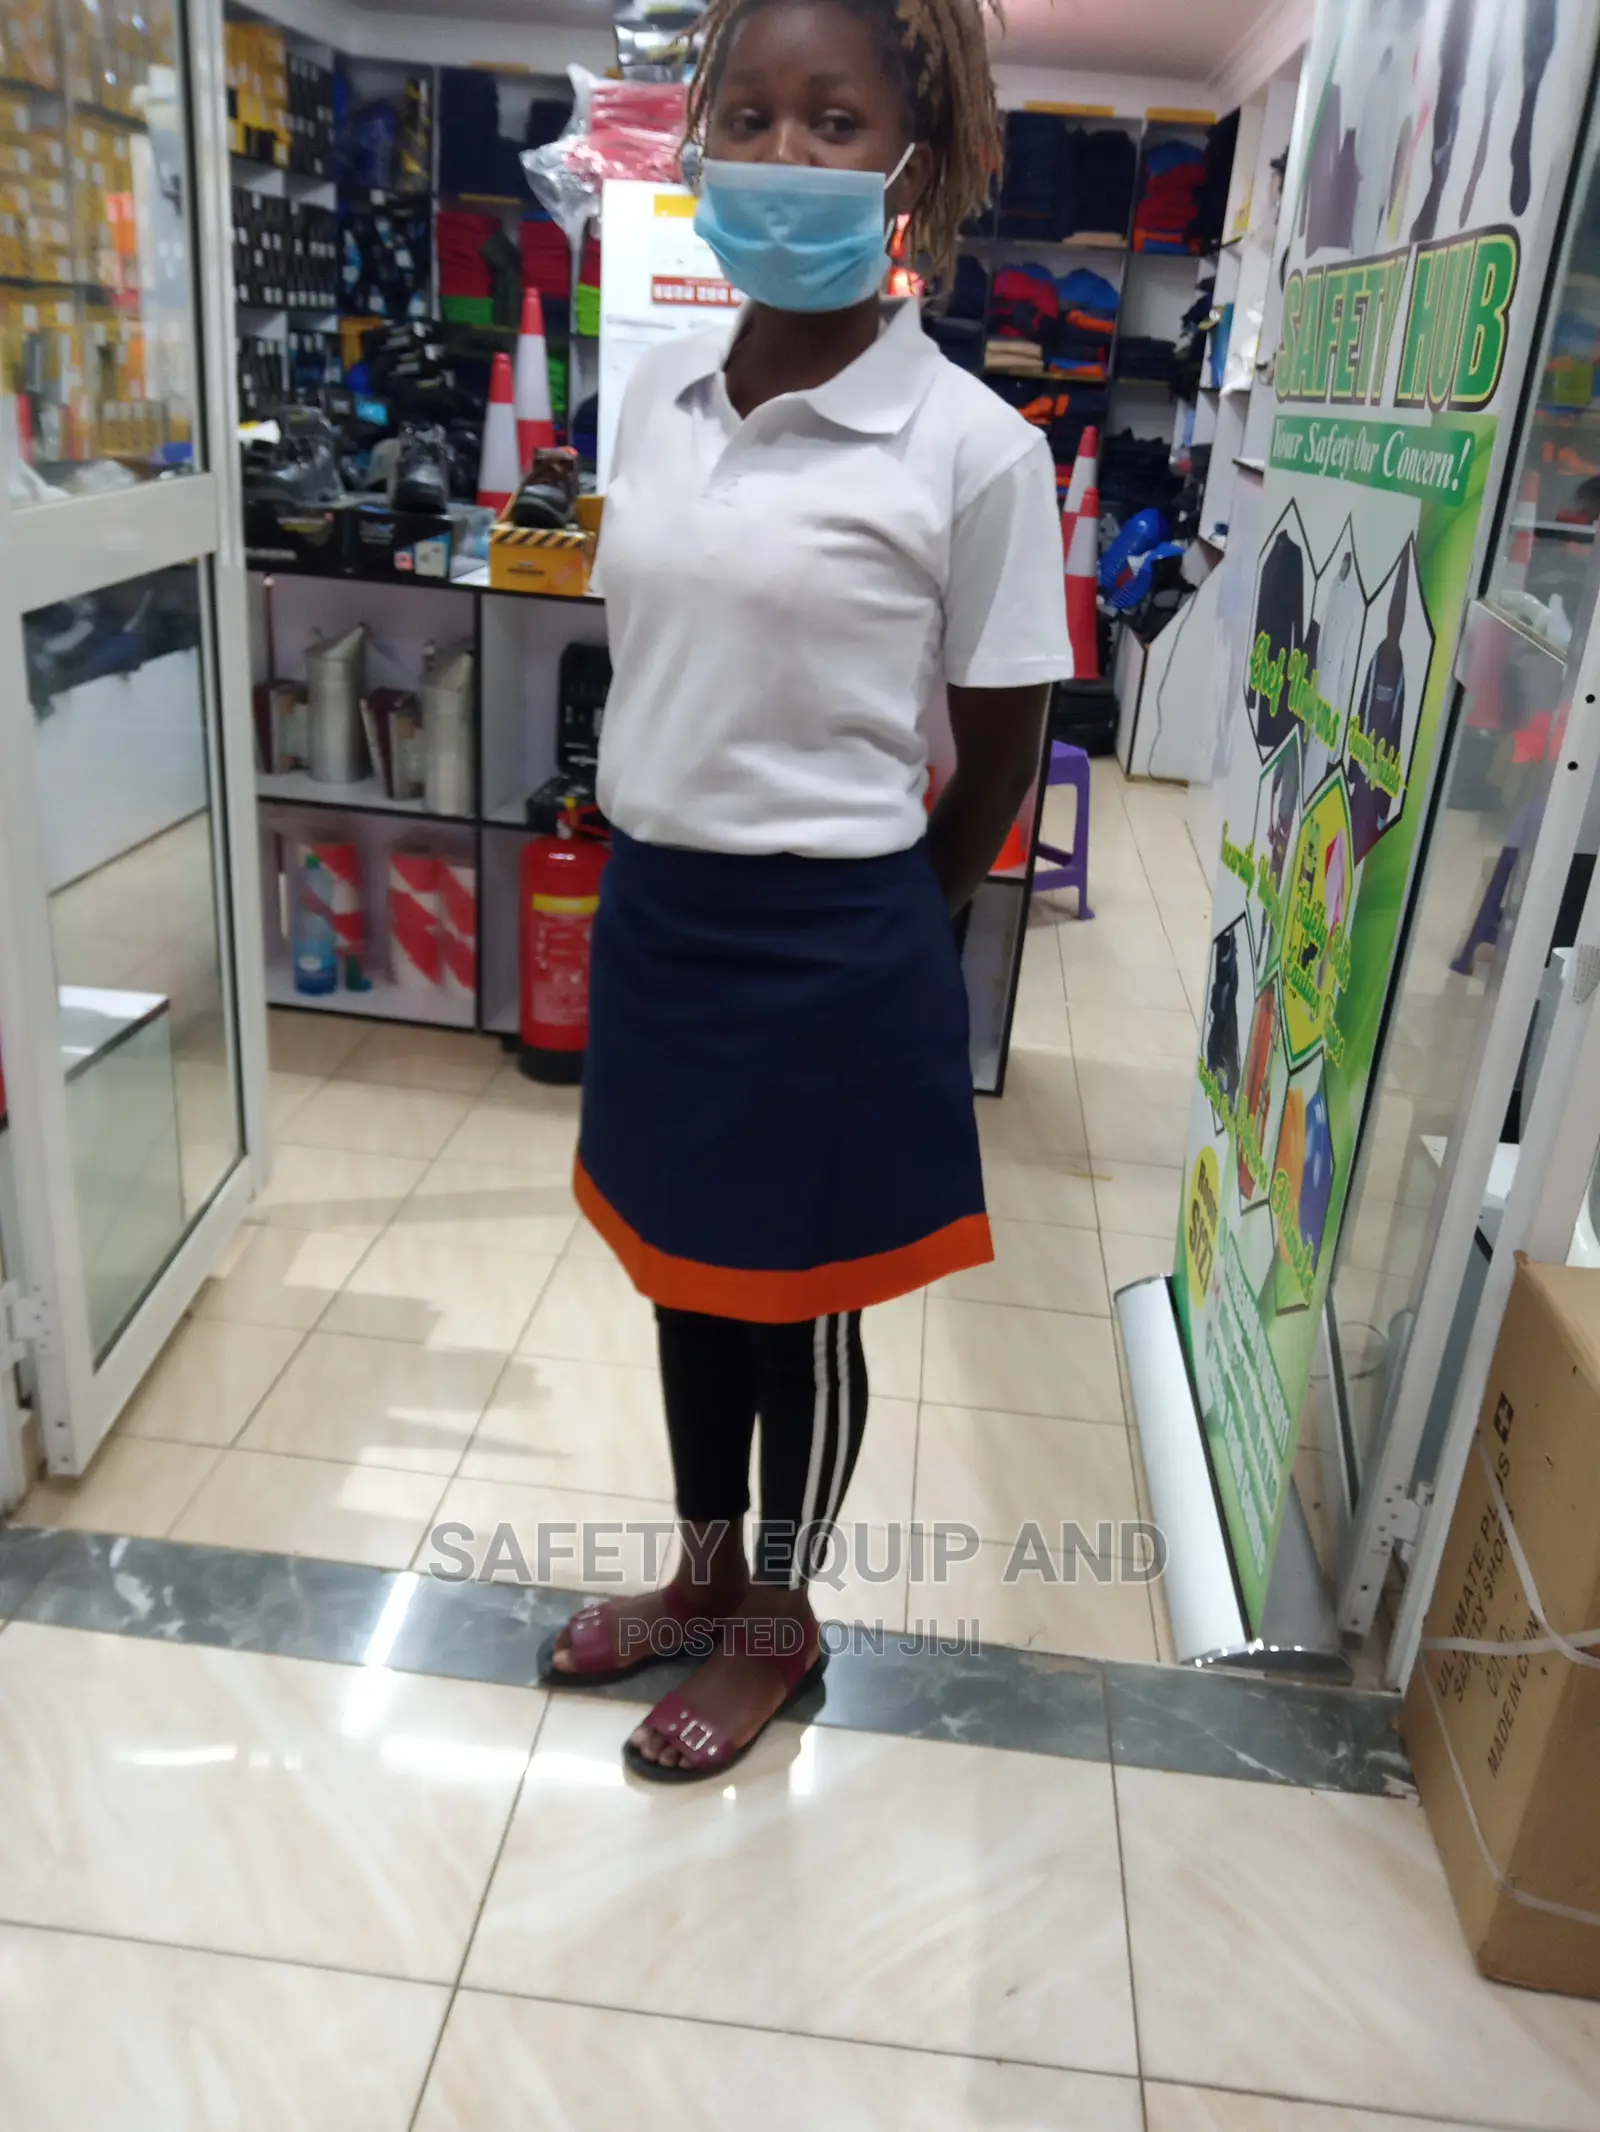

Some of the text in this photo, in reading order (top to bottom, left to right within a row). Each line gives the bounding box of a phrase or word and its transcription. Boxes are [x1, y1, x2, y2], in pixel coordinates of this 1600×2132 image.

[1274, 224, 1521, 412] SAFETY HUB
[1272, 418, 1471, 491] Your Safety Our Concern!
[1438, 1541, 1485, 1697] ULIMATE
[1454, 1596, 1487, 1703] SAFTY
[1487, 1700, 1515, 1780] MADE
[1508, 1671, 1521, 1710] IN
[1517, 1603, 1546, 1679] CIN
